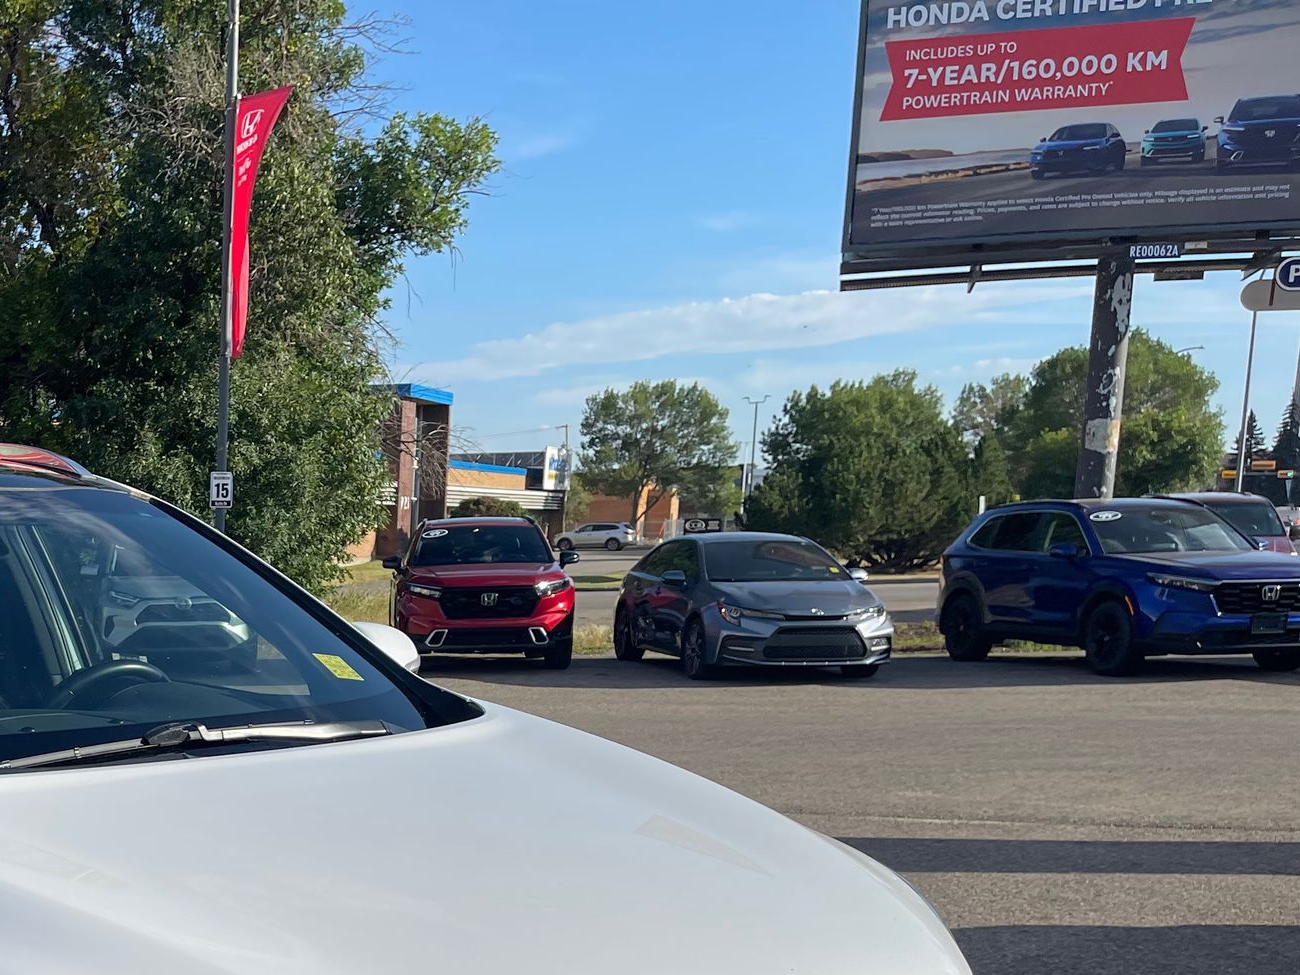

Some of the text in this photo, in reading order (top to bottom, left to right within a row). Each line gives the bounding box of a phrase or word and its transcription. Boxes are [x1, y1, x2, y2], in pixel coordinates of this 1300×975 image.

[887, 1, 989, 29] HONDA
[906, 42, 1017, 61] INCLUDES UP TO
[904, 50, 1168, 89] 7-YEAR/160,000 KM
[902, 90, 1010, 110] POWERTRAIN
[1129, 245, 1178, 258] RE00062A
[214, 483, 229, 498] 15
